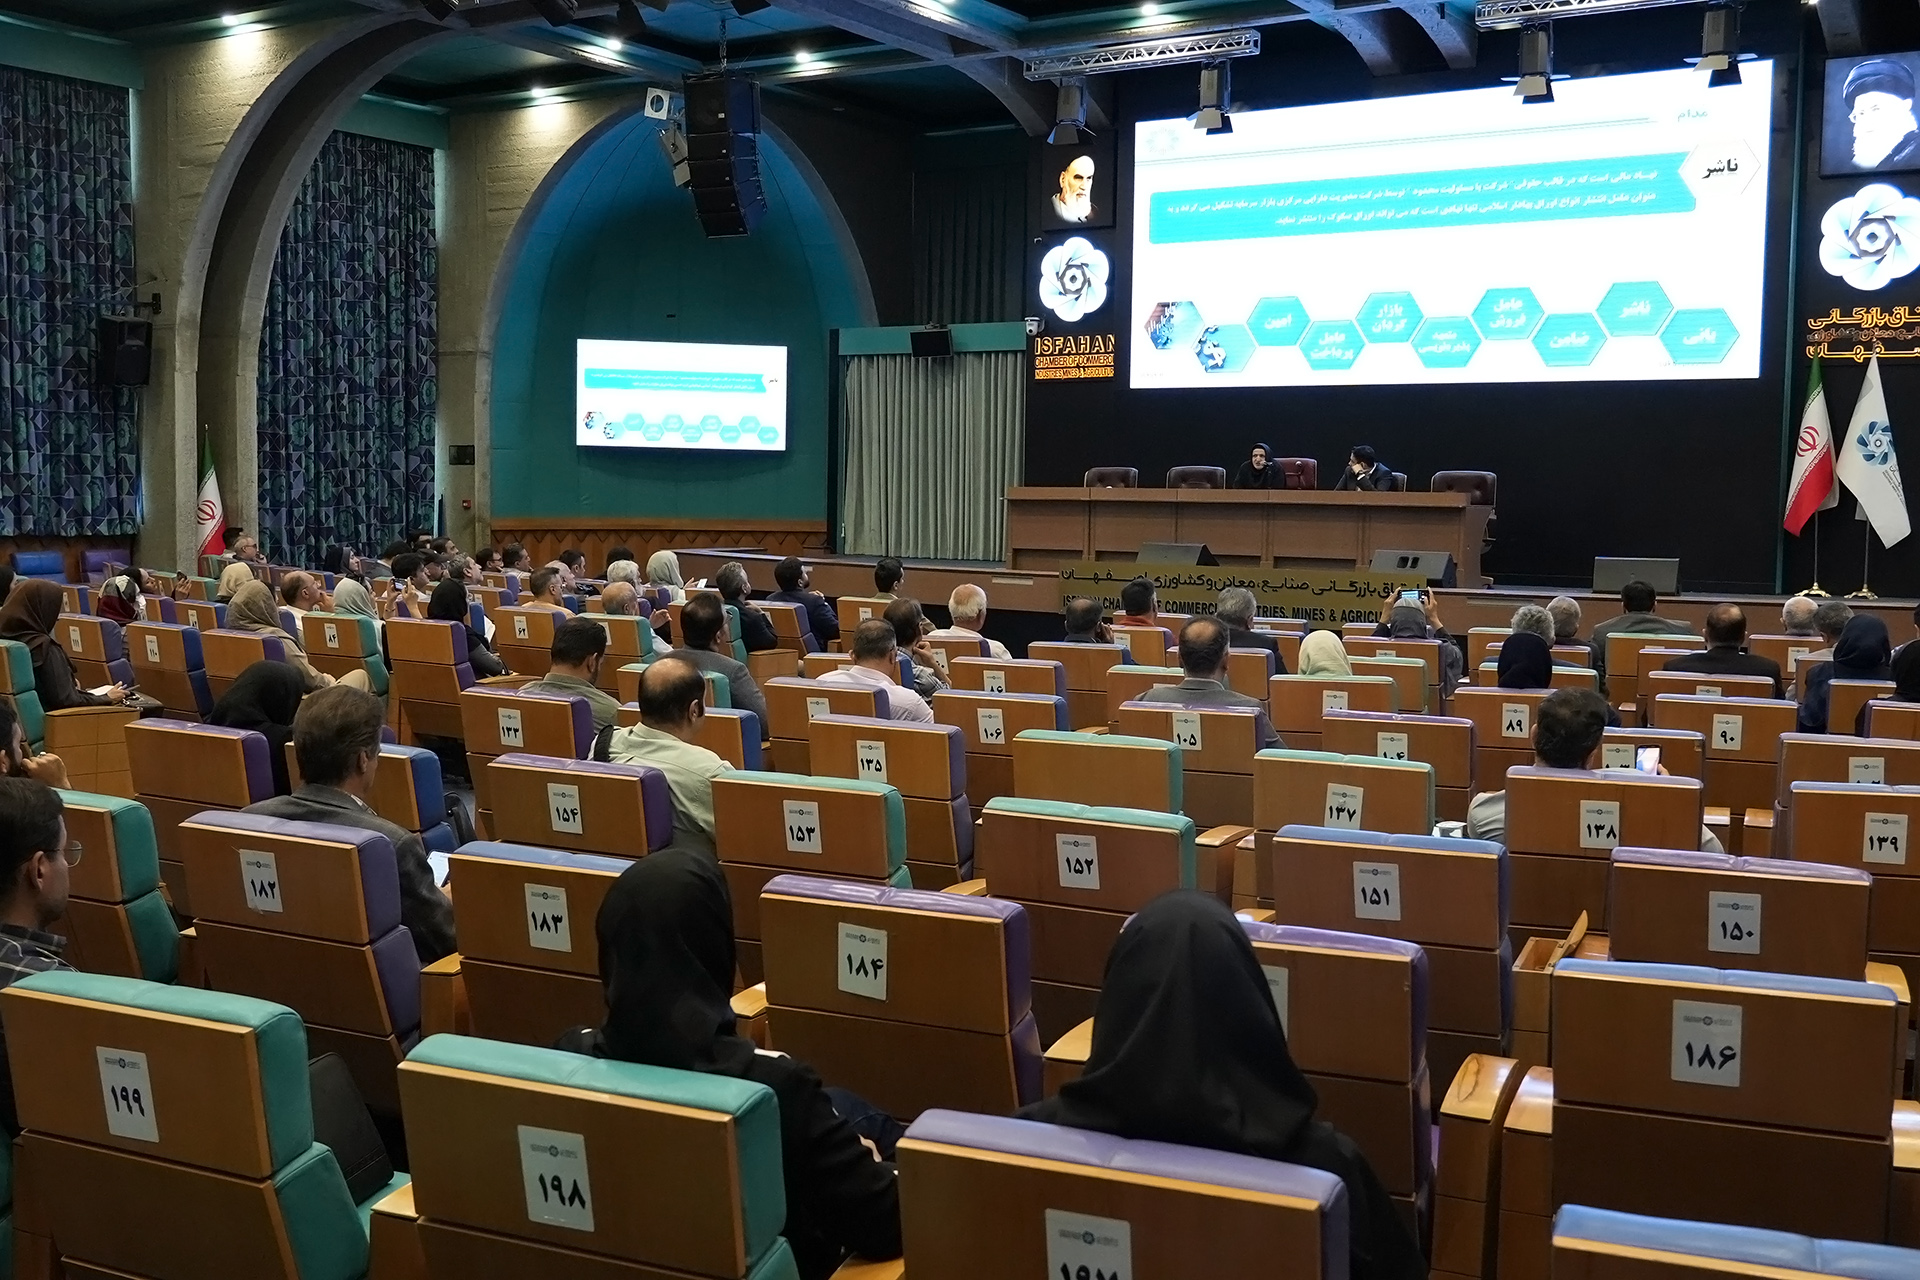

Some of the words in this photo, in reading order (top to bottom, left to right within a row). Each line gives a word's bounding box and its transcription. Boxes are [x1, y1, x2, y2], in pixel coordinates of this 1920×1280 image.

[1701, 157, 1739, 180] ناشر
[1577, 174, 1589, 183] که
[1589, 172, 1609, 183] است
[1376, 303, 1404, 319] بازار
[1493, 297, 1524, 313] عامل
[1618, 299, 1651, 318] ناشر
[1371, 318, 1408, 334] گردان
[1489, 312, 1527, 329] فروش
[1807, 306, 1889, 329] بازرگانی
[1035, 334, 1114, 354] ISFAHAN
[1318, 331, 1346, 346] عامل
[1549, 331, 1590, 349] ضامن
[1682, 326, 1718, 345] بانی
[1035, 356, 1068, 368] CHAMBER
[1068, 354, 1079, 368] OF
[1310, 346, 1354, 361] پرداخت
[1154, 573, 1206, 589] کشاورزی
[1214, 575, 1256, 591] معادن
[1312, 580, 1377, 598] بازرگانی
[1165, 600, 1217, 614] COMMERC
[1292, 606, 1325, 621] MINES
[1329, 608, 1337, 622] &
[328, 633, 337, 645] ۸۴
[501, 726, 520, 739] ۱۳۳
[984, 727, 1002, 740] ۱۰۶
[1506, 719, 1523, 732] ۸۹
[1177, 733, 1197, 746] ۱۰۵
[1720, 730, 1735, 744] ۹۰
[860, 757, 882, 772] ۱۳۵
[556, 807, 578, 823] ۱۵۴
[1329, 805, 1356, 822] ۱۳۷
[789, 825, 816, 842] ۱۵۳
[1587, 823, 1617, 840] ۱۳۸
[1869, 835, 1899, 852] ۱۳۹
[1065, 856, 1094, 875] ۱۵۲
[250, 879, 276, 899] ۱۸۲
[1361, 886, 1390, 906] ۱۵۱
[531, 911, 562, 934] ۱۸۳
[1720, 920, 1754, 941] ۱۵۰
[846, 953, 884, 980] ۱۸۴
[1685, 1041, 1737, 1070] ۱۸۶
[111, 1086, 145, 1117] ۱۹۹
[539, 1173, 586, 1209] ۱۹۸
